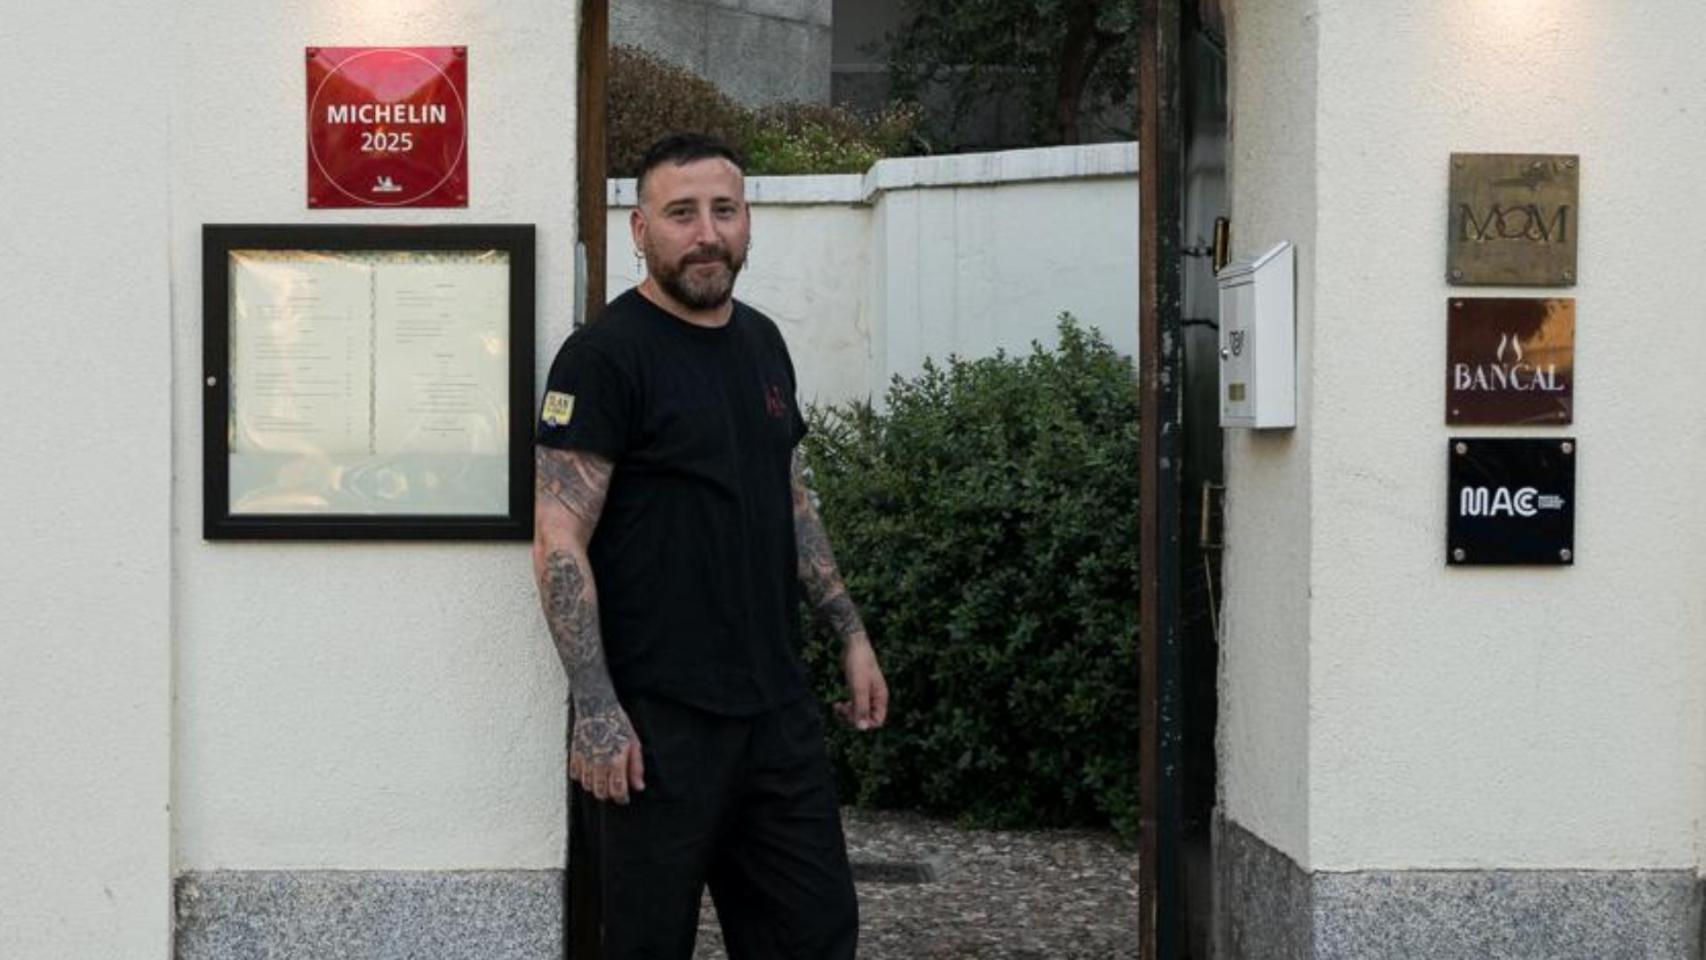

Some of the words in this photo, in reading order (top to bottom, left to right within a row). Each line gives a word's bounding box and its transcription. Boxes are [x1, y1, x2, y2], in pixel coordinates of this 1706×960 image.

[327, 104, 447, 124] MICHELIN
[360, 132, 414, 151] 2025
[1454, 363, 1565, 391] BANCAL
